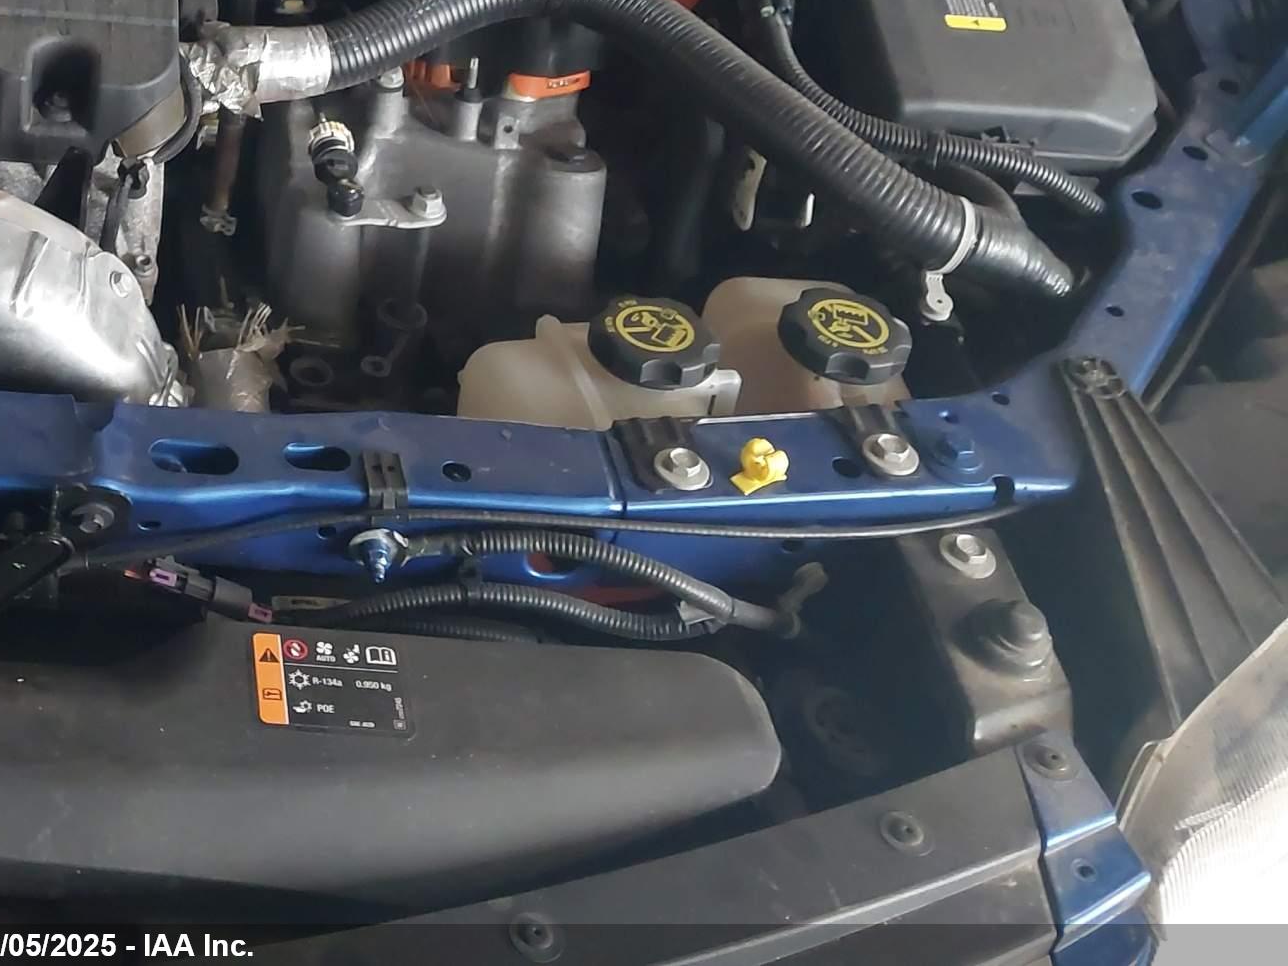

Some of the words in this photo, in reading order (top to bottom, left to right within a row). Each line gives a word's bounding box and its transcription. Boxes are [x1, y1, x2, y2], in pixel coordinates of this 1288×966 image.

[316, 654, 336, 662] AUTO
[312, 677, 343, 687] R-134a
[380, 682, 392, 692] kg
[316, 704, 335, 713] POE
